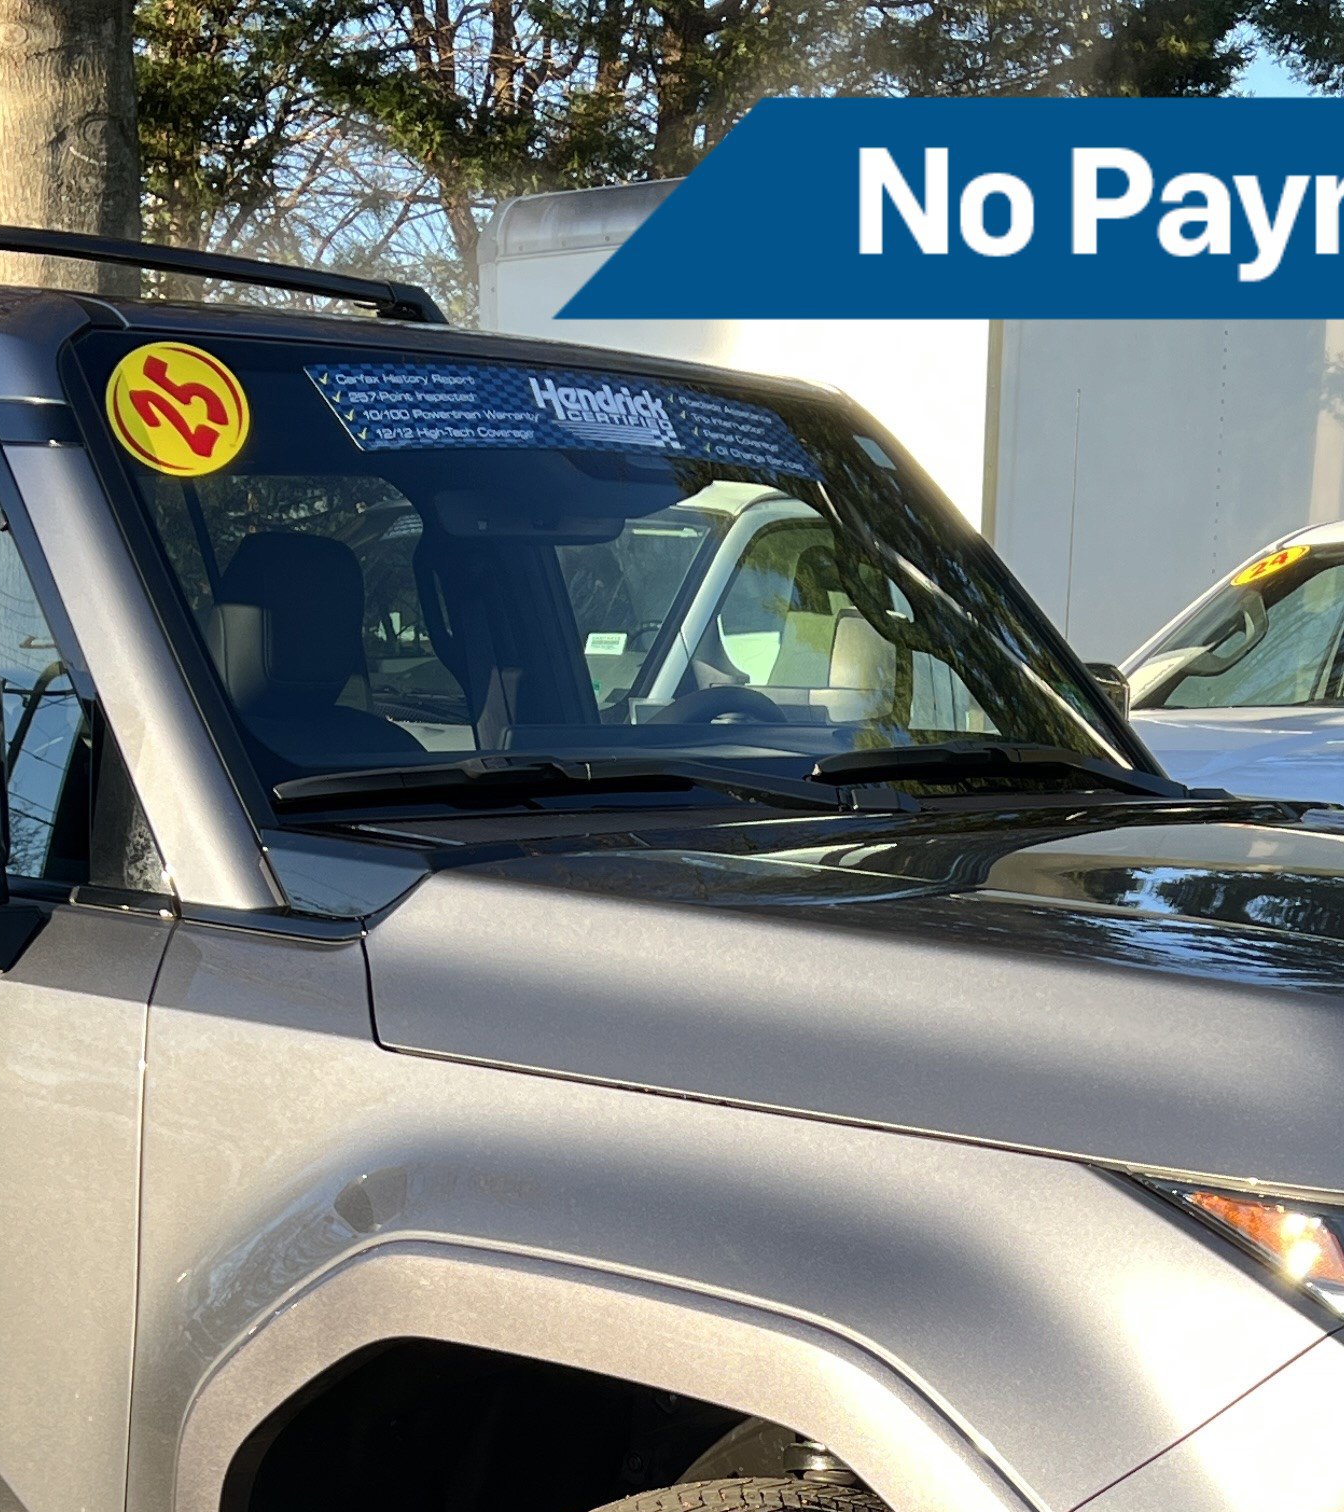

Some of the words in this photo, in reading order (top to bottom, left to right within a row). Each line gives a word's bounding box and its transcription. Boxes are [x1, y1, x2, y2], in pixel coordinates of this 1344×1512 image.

[335, 373, 380, 386] Carfax
[382, 373, 429, 386] History
[431, 373, 476, 386] Report
[129, 355, 230, 459] 25
[528, 377, 670, 421] Hendrick
[362, 409, 410, 421] 10/100
[567, 410, 674, 431] CERTIFIED
[375, 428, 413, 440] 12/12
[416, 427, 475, 440] High-Tech
[476, 427, 535, 440] Coverage
[1249, 551, 1289, 579] 24
